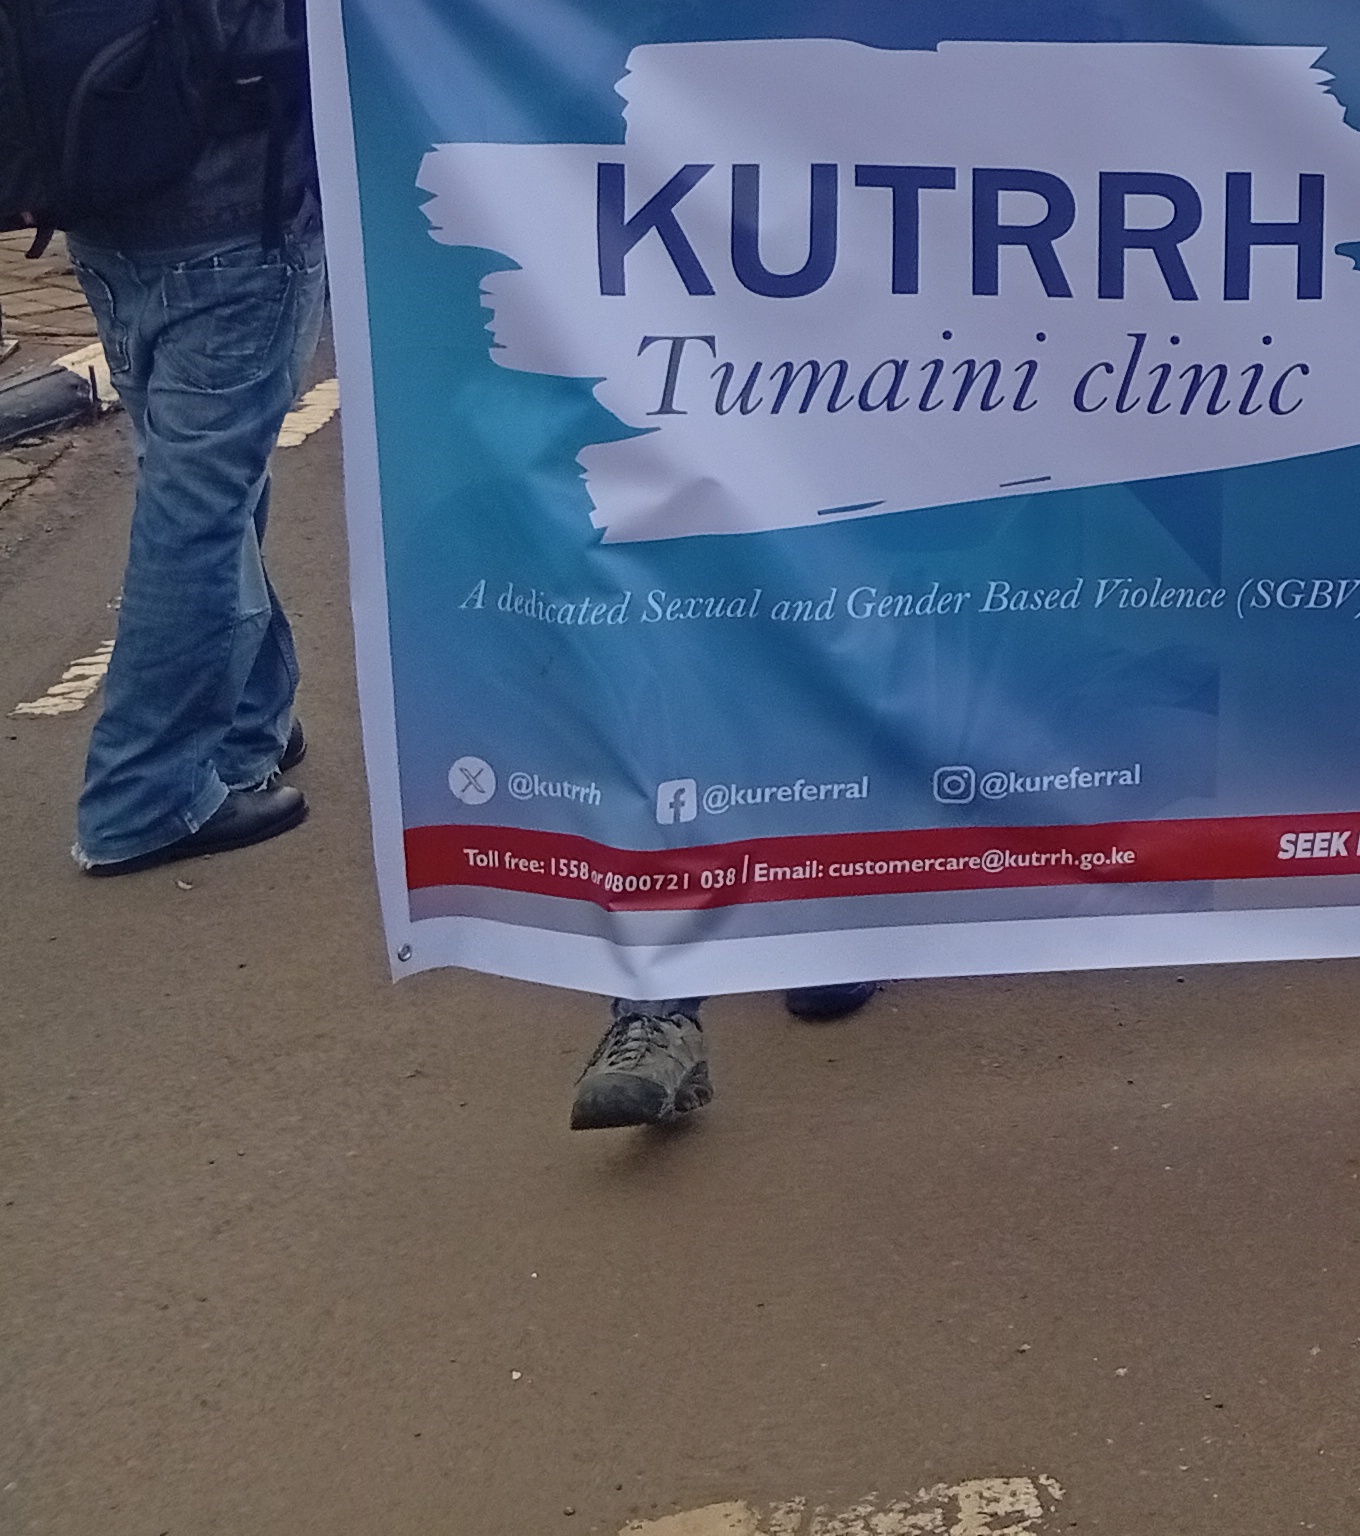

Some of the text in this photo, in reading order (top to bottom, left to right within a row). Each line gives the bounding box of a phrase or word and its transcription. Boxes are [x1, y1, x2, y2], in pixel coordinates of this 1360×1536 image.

[598, 163, 1324, 301] KUTRRH
[636, 330, 1310, 416] Tumaini clinic
[458, 580, 488, 610] A
[498, 582, 630, 625] dedicated
[641, 589, 761, 624] Sexual
[771, 588, 837, 623] and
[847, 582, 970, 620] Gender
[979, 578, 1083, 613] Based
[1093, 578, 1226, 610] Violence
[507, 772, 602, 806] @kutrrh
[702, 777, 869, 814] @kureferral
[979, 765, 1141, 800] @kureferral
[1278, 831, 1352, 859] SEEK
[463, 848, 499, 868] Toll
[504, 852, 545, 874] free:
[700, 867, 736, 889] 038
[754, 862, 824, 882] Email:
[828, 847, 1136, 878] customercare@kutrrh.go.ke
